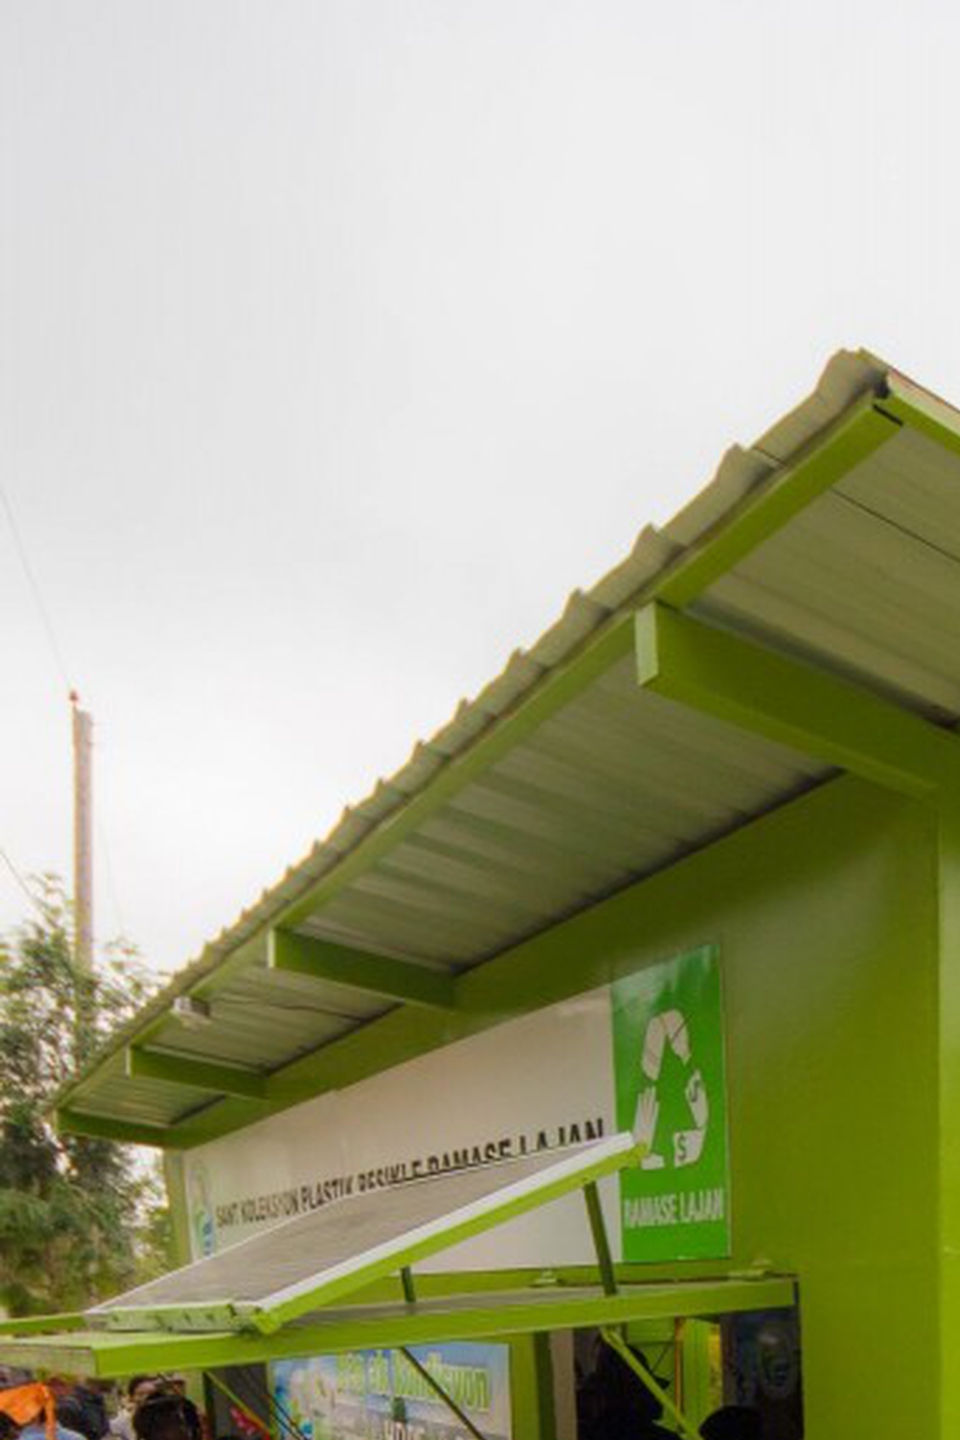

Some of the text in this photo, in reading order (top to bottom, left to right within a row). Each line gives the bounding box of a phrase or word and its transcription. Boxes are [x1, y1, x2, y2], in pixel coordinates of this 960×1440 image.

[301, 1174, 354, 1213] PLASTIK
[624, 1187, 724, 1229] RAMASE LAJAN
